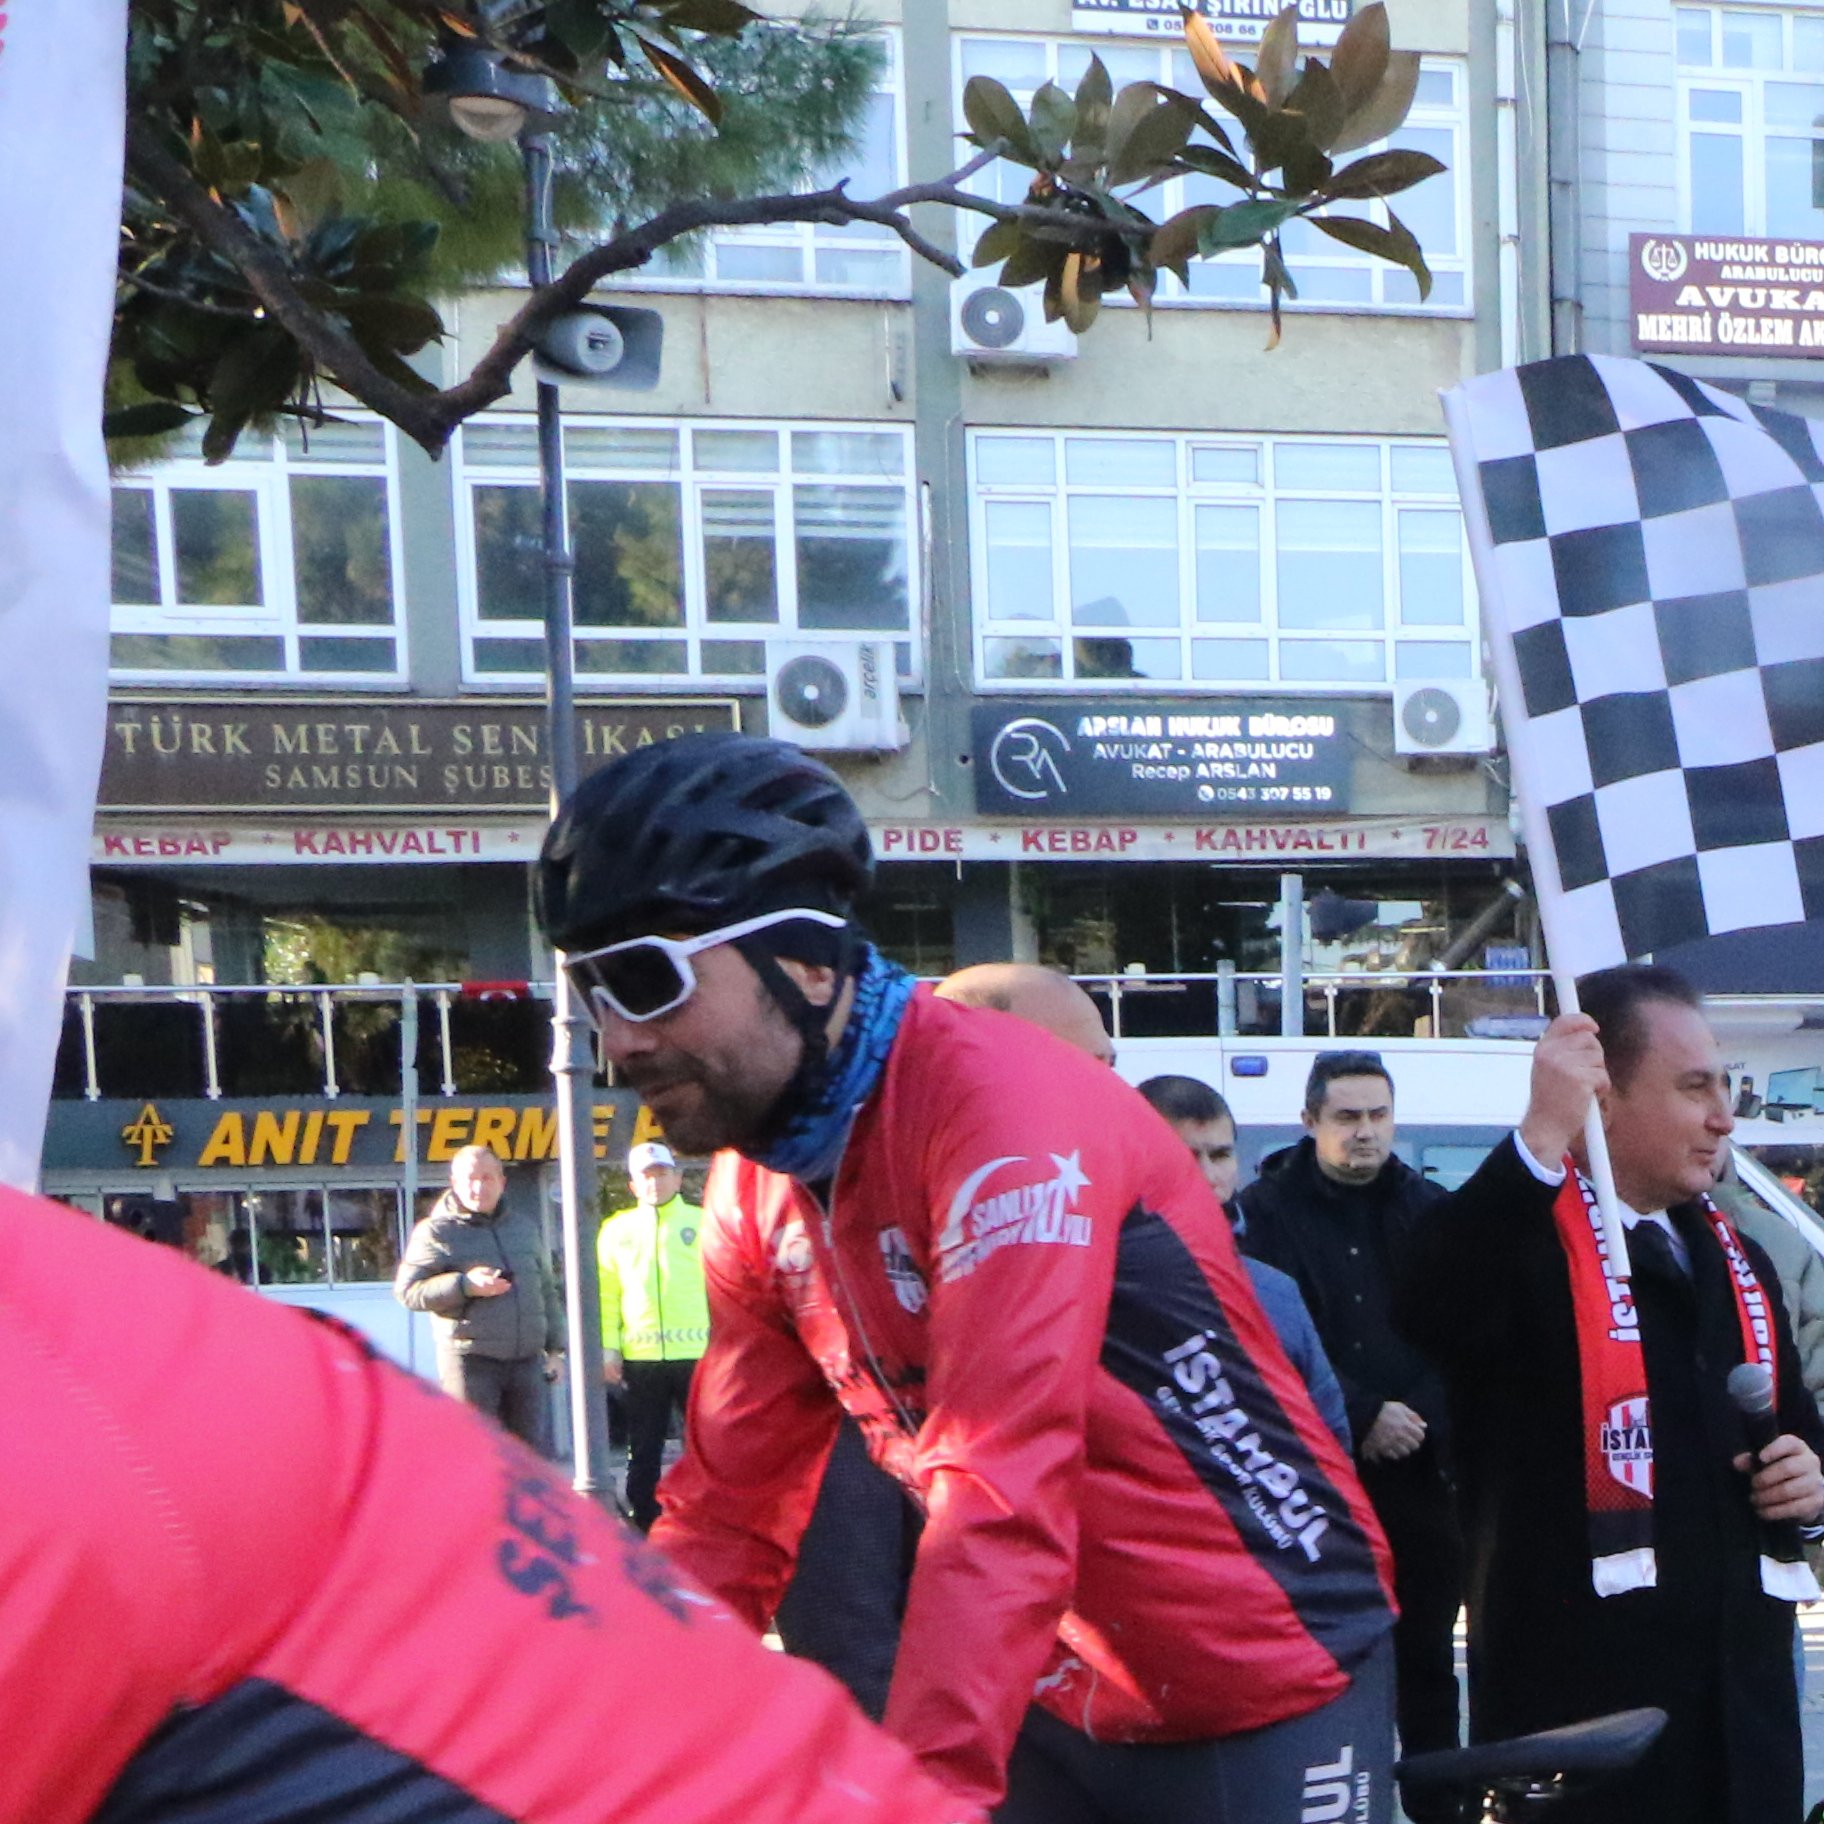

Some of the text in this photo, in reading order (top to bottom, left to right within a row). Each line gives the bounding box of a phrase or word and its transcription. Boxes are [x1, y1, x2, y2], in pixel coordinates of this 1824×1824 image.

[1695, 242, 1769, 262] HUKUK
[1721, 265, 1824, 282] ARABULUCU
[1638, 311, 1712, 342] MEHRİ
[1718, 311, 1793, 345] ÖZLEM
[115, 715, 252, 755] TÜRK
[273, 723, 431, 755] METAL
[1078, 713, 1334, 737] ARSLAN HUKUK BÜROSU
[1093, 743, 1172, 759] AVUKAT
[1191, 743, 1314, 759] ARABULUCU
[266, 764, 553, 795] SAMSUN ŞUBES
[1131, 763, 1276, 781] Recep ARSLAN
[104, 830, 480, 856] KEBAP KAHVALTI
[1021, 828, 1139, 852] KEBAP
[1195, 827, 1367, 852] KAHVALTI
[1422, 827, 1490, 851] 7/24
[199, 1110, 370, 1167] ANIT
